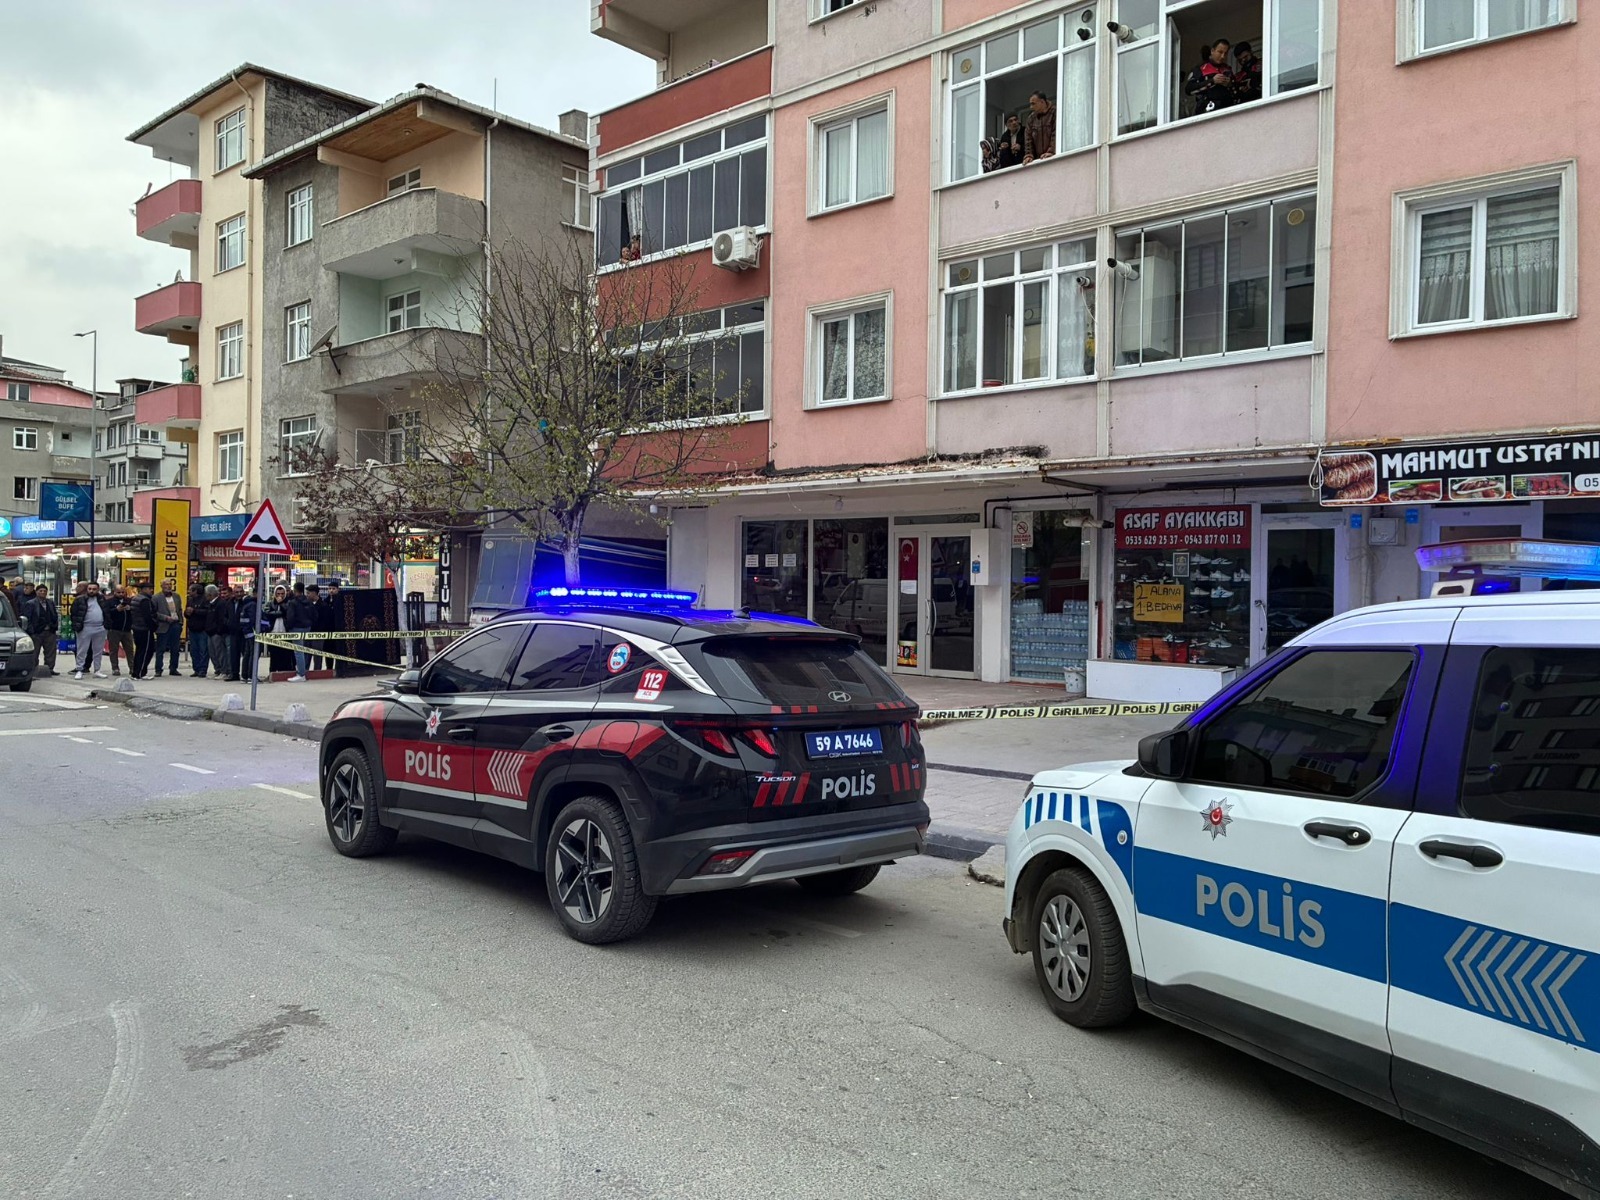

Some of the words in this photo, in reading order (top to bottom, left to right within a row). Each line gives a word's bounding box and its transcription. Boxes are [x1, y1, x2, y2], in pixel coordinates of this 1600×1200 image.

[1381, 447, 1492, 479] MAHMUT
[54, 495, 78, 503] GÜLSEL
[58, 502, 75, 510] BÜFE
[201, 522, 219, 533] GÜLSEL
[219, 521, 232, 532] BÜFE
[1123, 512, 1160, 530] ASAF
[1164, 510, 1245, 529] AYAKKABI
[162, 530, 179, 561] BÜFE
[1125, 535, 1142, 545] 0535
[1144, 535, 1157, 545] 629
[1158, 535, 1168, 545] 25
[1169, 535, 1179, 545] 37
[1184, 534, 1203, 545] 0543
[1204, 534, 1218, 545] 877
[1220, 534, 1229, 544] 01
[1232, 534, 1241, 544] 12
[203, 545, 225, 557] GÜLSEL
[1136, 584, 1148, 600] 2
[1150, 586, 1181, 596] ALANA
[1136, 600, 1145, 616] 1
[643, 672, 663, 689] 112
[926, 710, 984, 719] GİRİLMEZ
[1000, 708, 1035, 718] POLİS
[1052, 706, 1107, 716] GİRİLMEZ
[1122, 705, 1157, 714] POLİS
[1172, 703, 1200, 713] GİRİL
[815, 736, 832, 752] 59
[834, 736, 844, 751] A
[844, 733, 874, 750] 7646
[404, 745, 452, 781] POLİS
[821, 769, 876, 800] POLİS
[1196, 874, 1326, 948] POLİS
